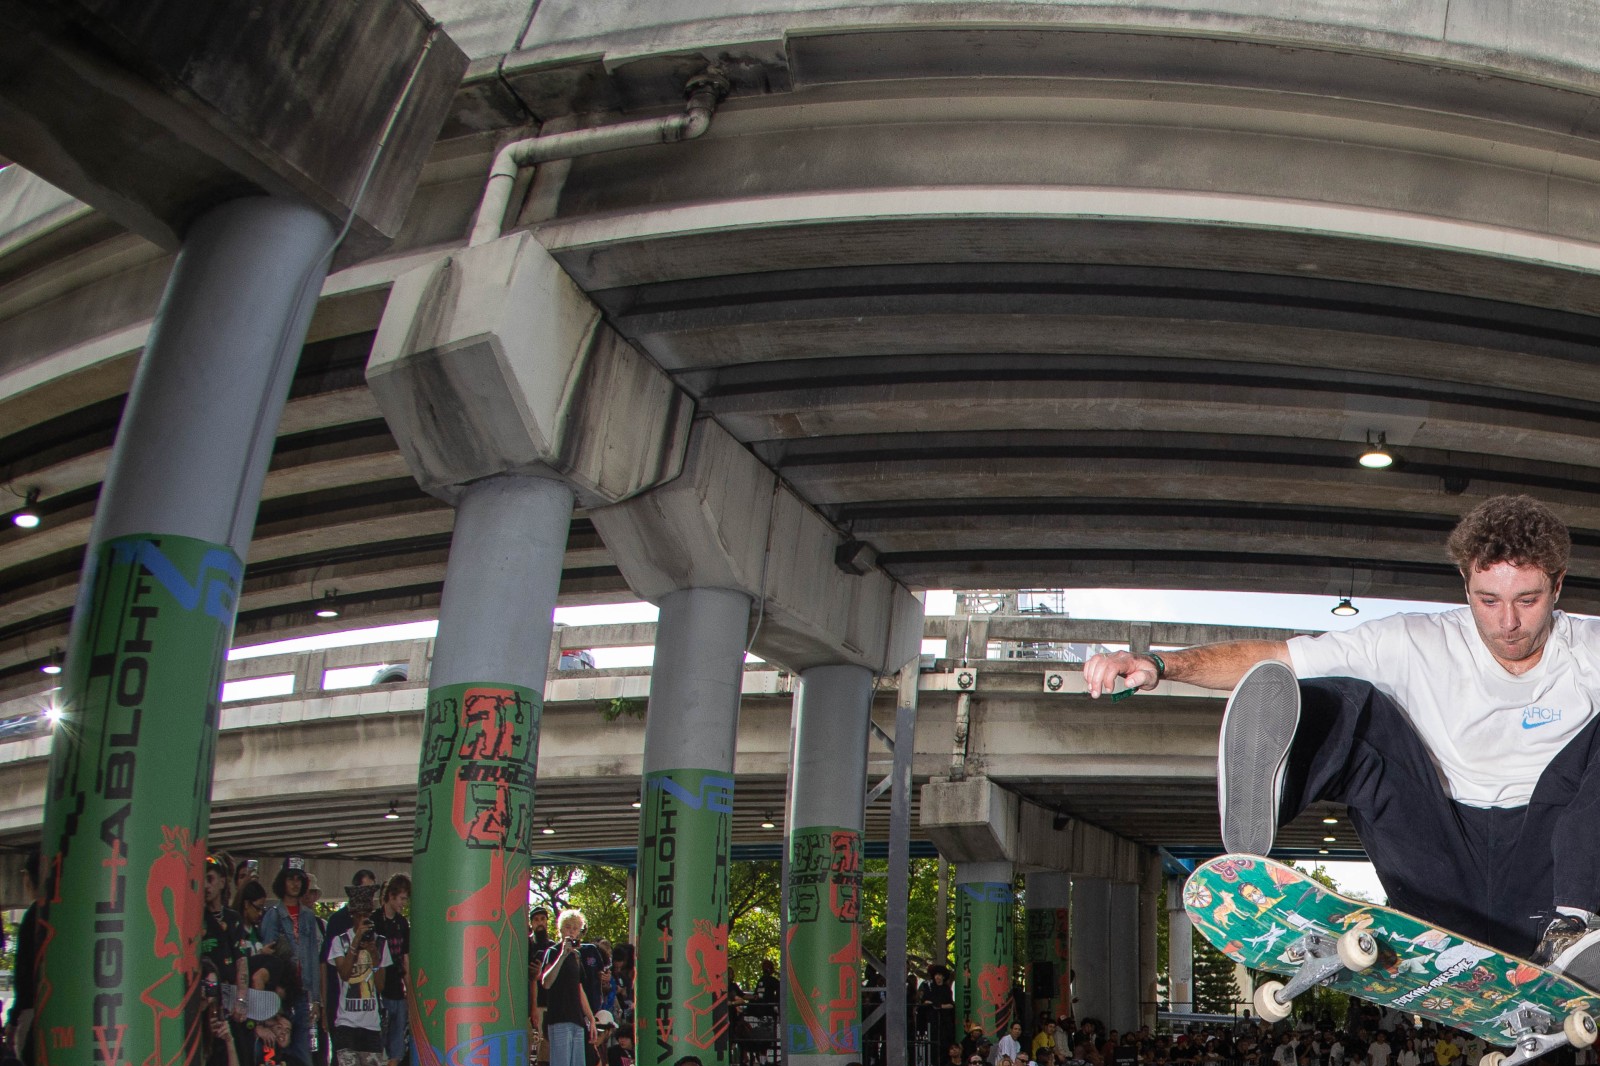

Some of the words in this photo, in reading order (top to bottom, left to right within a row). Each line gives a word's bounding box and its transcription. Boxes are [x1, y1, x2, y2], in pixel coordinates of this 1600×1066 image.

[1523, 707, 1562, 720] ARCH
[1430, 958, 1474, 988] AWESOME
[345, 999, 361, 1012] KILL
[656, 942, 675, 1064] VIRGIL
